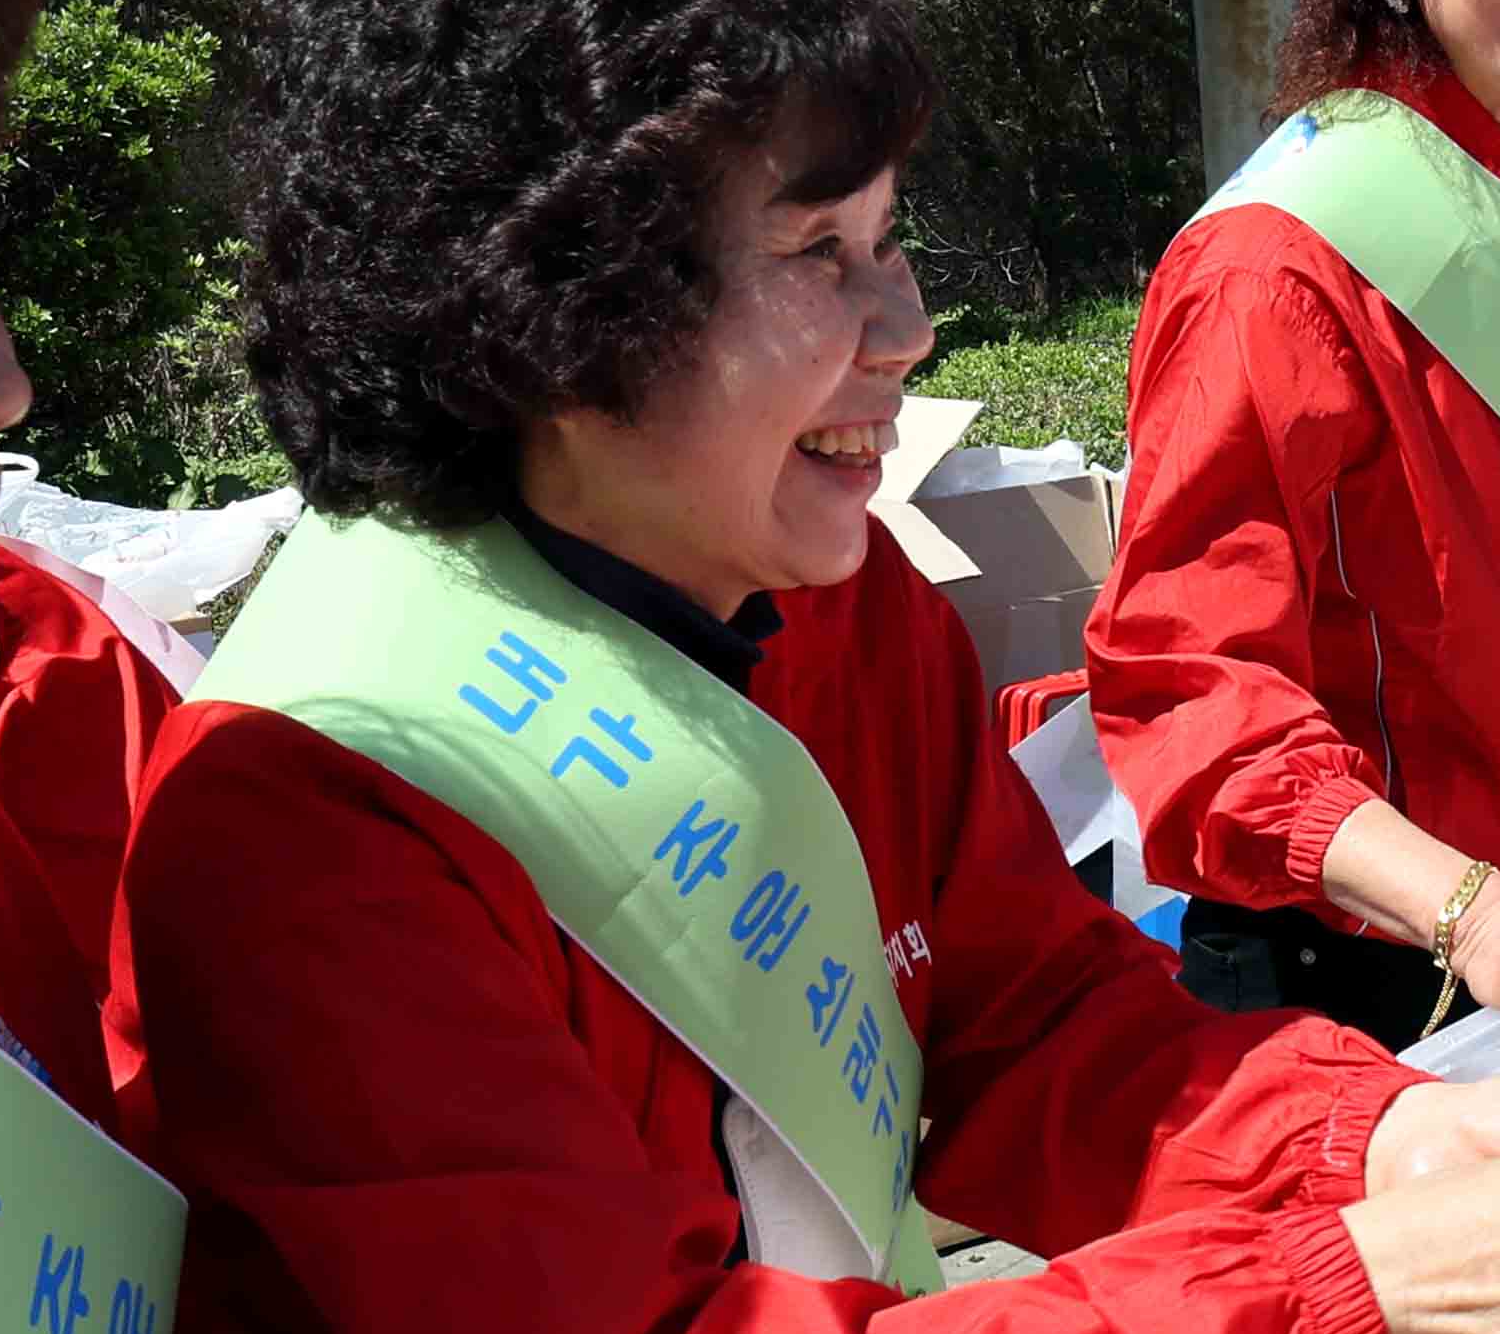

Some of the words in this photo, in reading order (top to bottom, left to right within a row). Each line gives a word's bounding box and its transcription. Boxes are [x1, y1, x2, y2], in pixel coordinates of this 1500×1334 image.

[457, 630, 654, 789] 내가
[653, 798, 812, 972] 주운
[805, 955, 900, 1137] 쓰레기
